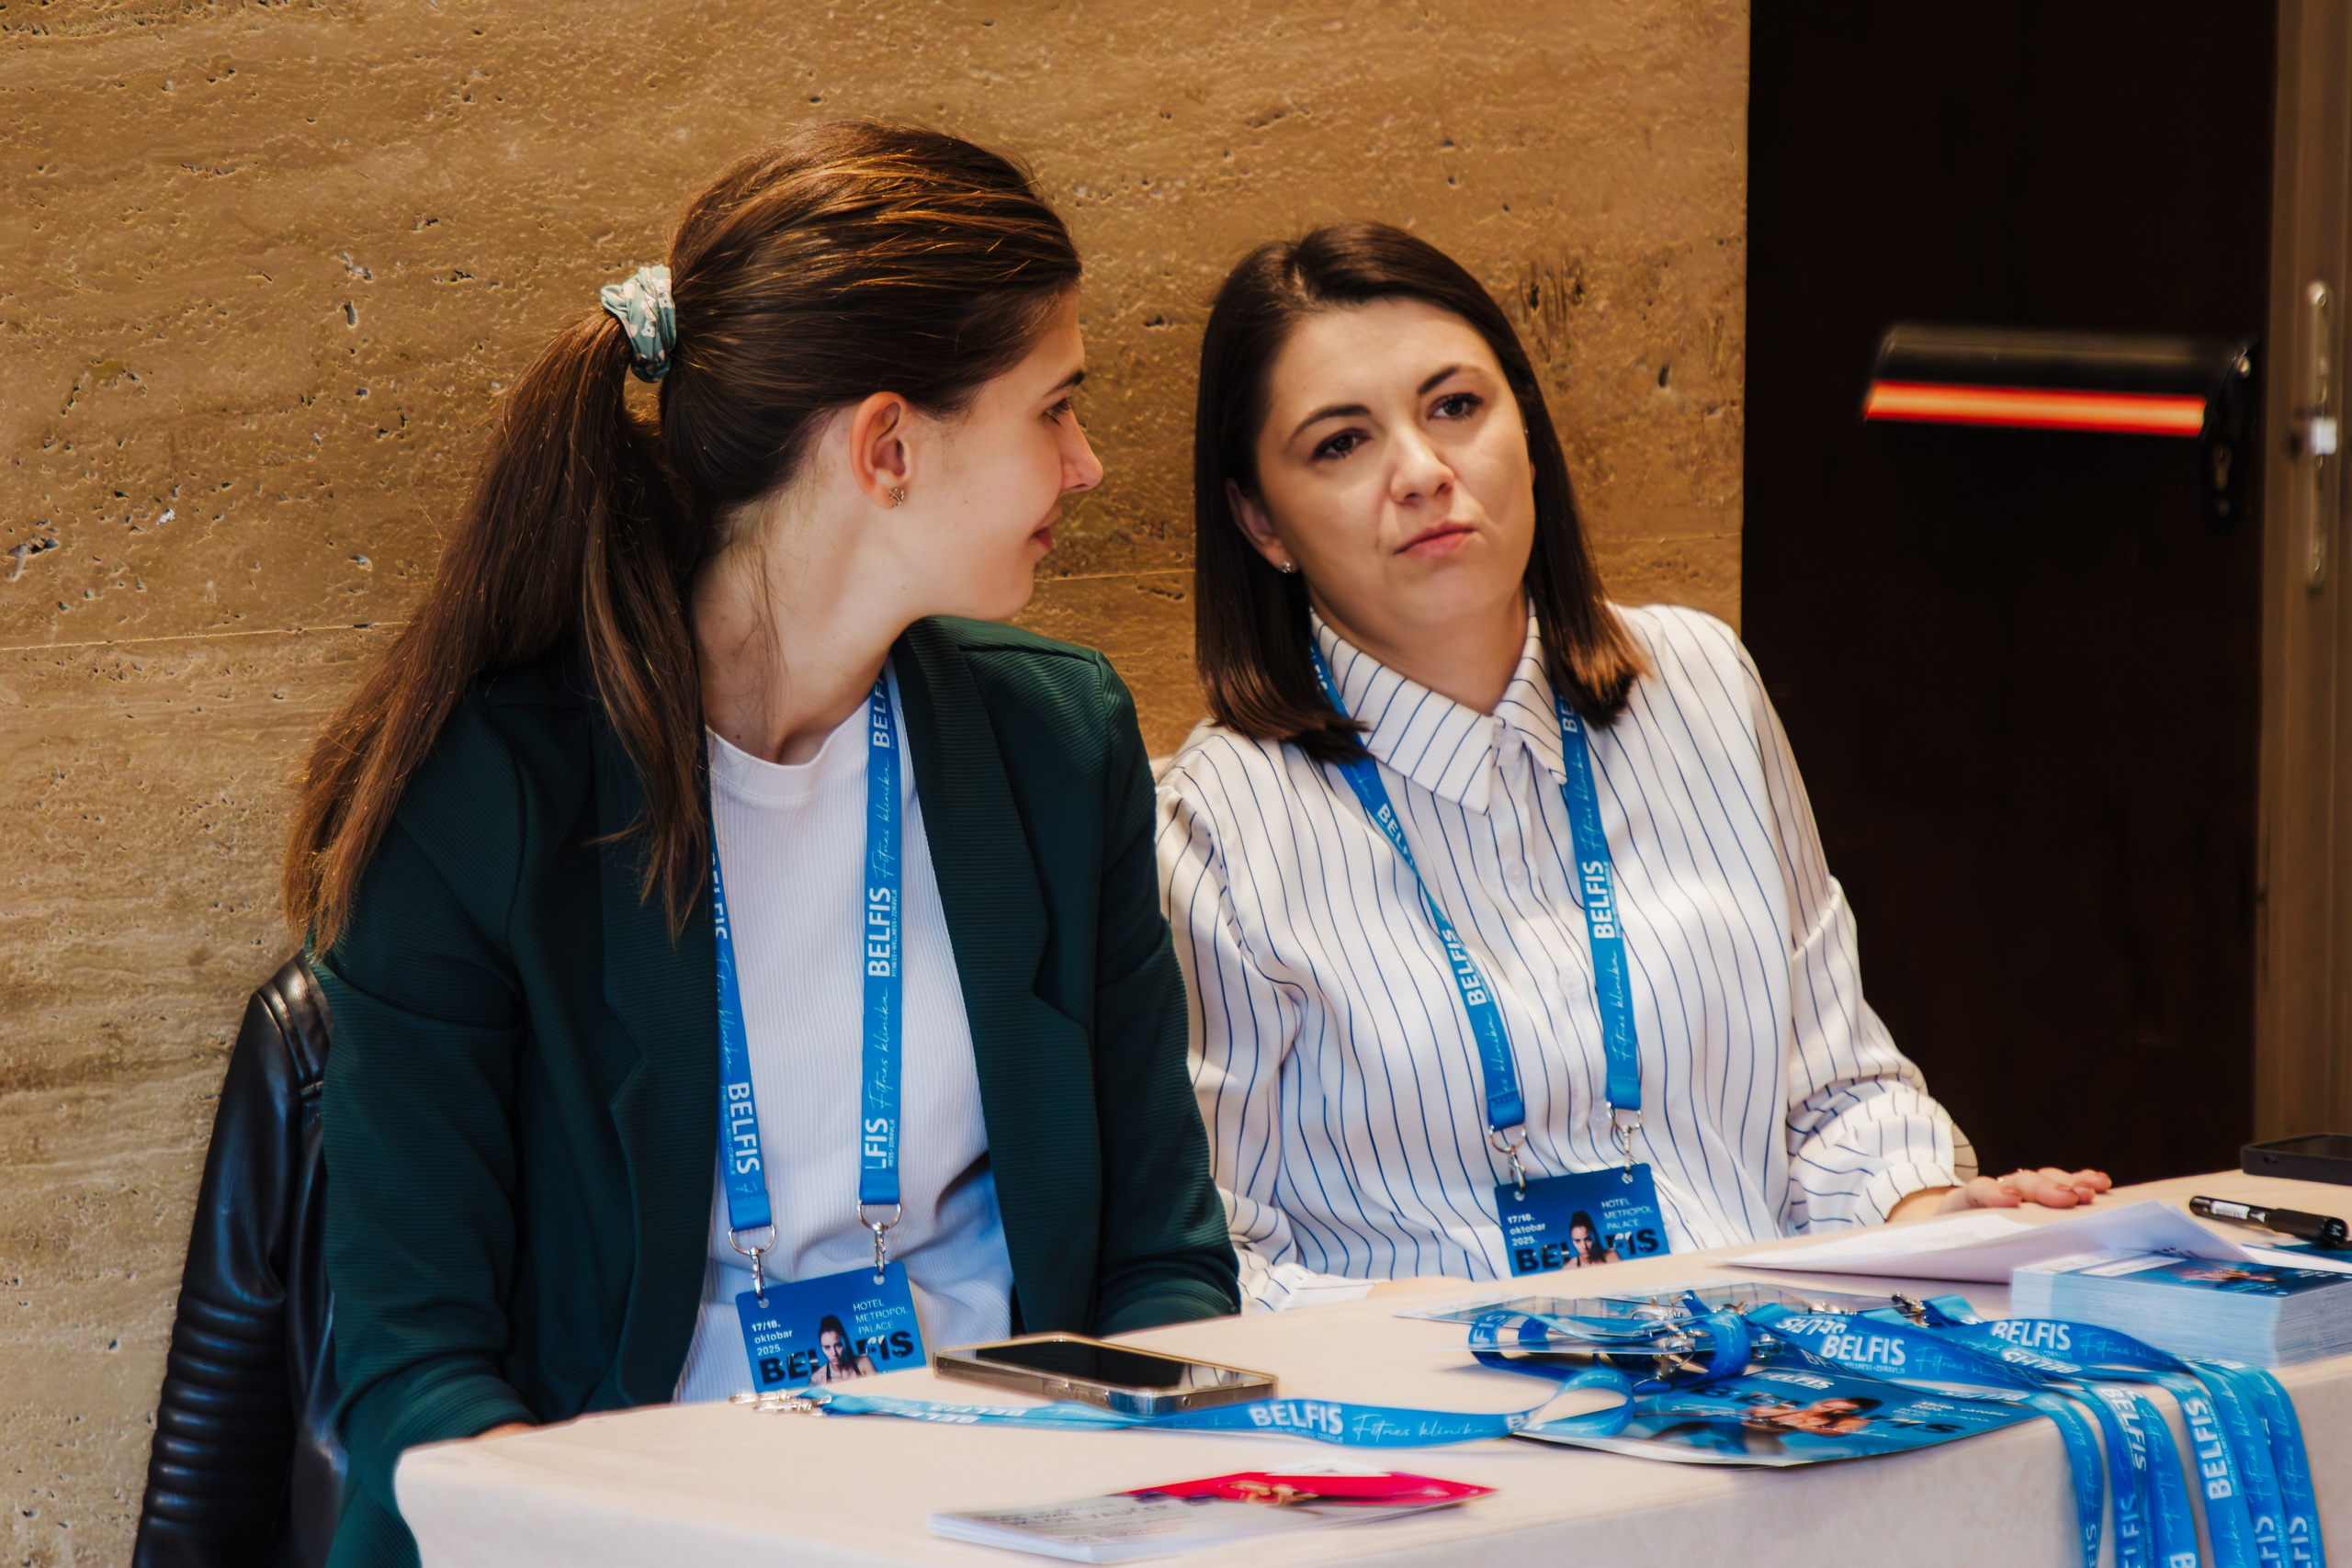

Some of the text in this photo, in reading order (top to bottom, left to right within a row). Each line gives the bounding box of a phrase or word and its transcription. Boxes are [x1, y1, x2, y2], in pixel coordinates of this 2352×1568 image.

[876, 756, 891, 822] klinika
[1582, 861, 1616, 938] BELFIS
[868, 887, 891, 976] BELFIS
[1442, 928, 1487, 1006] BELFIS
[1606, 950, 1624, 1009] klinika
[873, 986, 889, 1053] klinika
[728, 1082, 761, 1174] BELFIS
[1601, 1198, 1631, 1209] HOTEL
[1604, 1205, 1653, 1220] METROPOL
[1510, 1223, 1545, 1235] oktobar
[1607, 1218, 1639, 1230] PALACE
[853, 1299, 885, 1312] HOTEL
[855, 1306, 909, 1324] METROPOL
[754, 1330, 793, 1344] oktobar
[858, 1321, 895, 1335] PALACE
[1990, 1321, 2072, 1351] BELFIS
[1820, 1335, 1906, 1366] BELFIS
[1249, 1403, 1344, 1436] BELFIS
[1352, 1414, 1410, 1441] Fitnes
[2099, 1388, 2147, 1472] BELFIS
[2185, 1396, 2233, 1500] BELFIS
